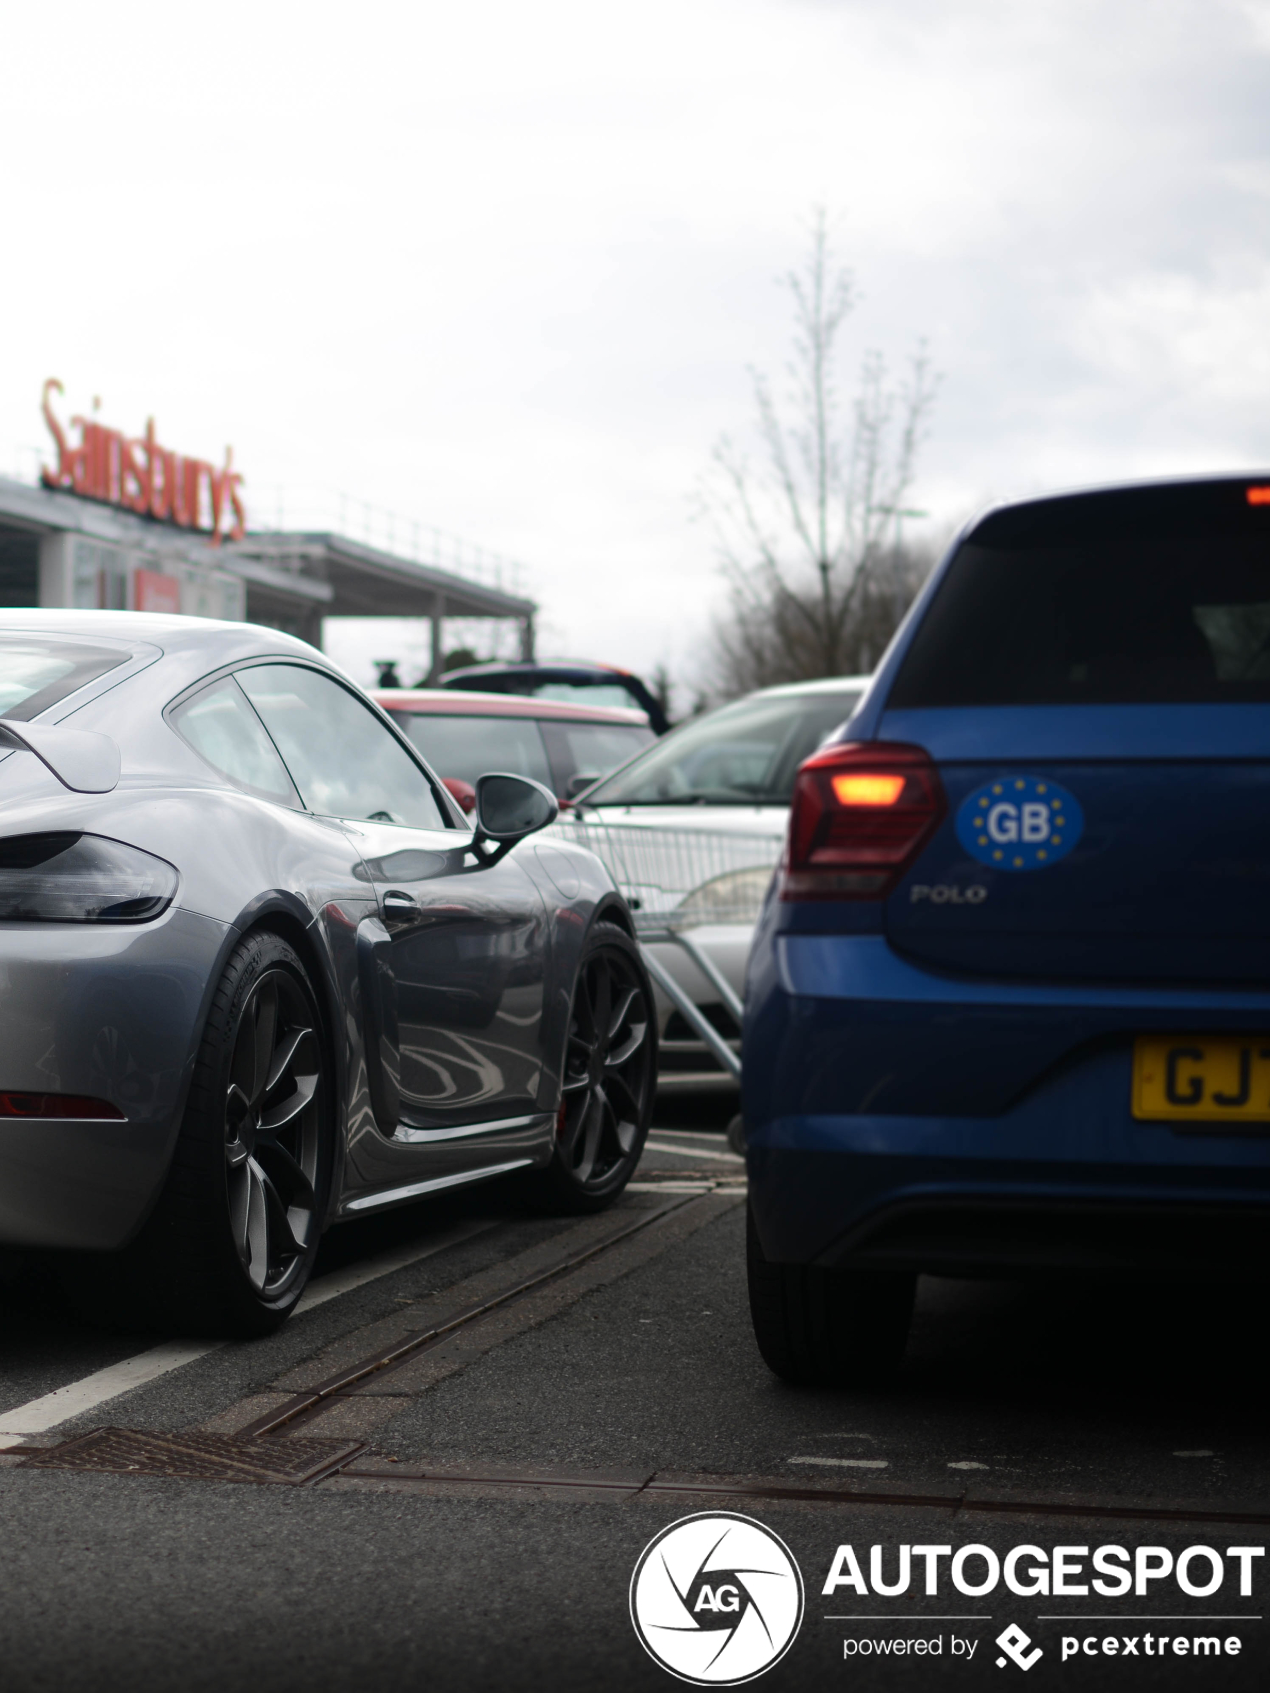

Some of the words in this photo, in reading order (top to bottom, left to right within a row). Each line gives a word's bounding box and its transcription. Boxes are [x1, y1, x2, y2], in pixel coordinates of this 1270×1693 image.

[41, 378, 245, 548] Sainsbury's
[987, 802, 1052, 844] GB
[909, 884, 988, 904] POLO
[1165, 1046, 1270, 1107] GJ
